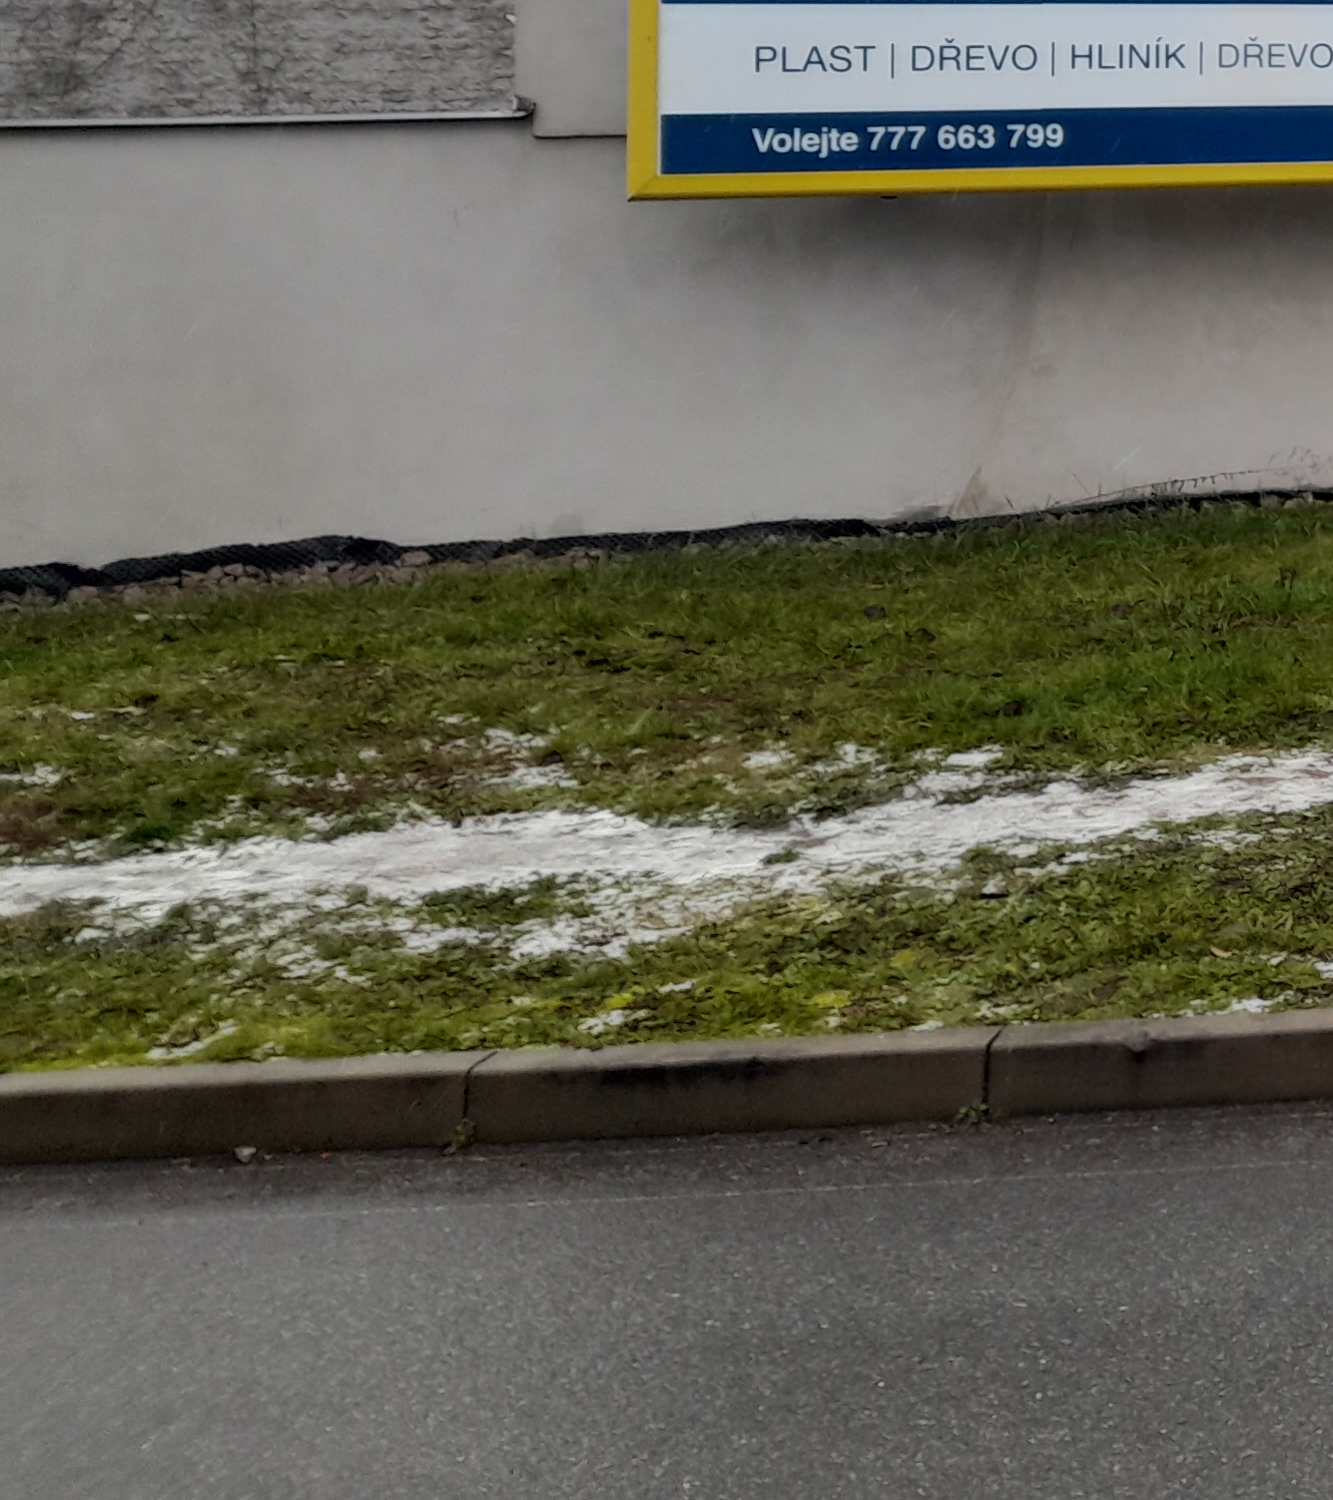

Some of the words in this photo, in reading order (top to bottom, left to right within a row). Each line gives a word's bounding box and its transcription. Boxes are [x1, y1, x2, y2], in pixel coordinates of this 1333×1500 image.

[755, 45, 876, 73] PLAST
[911, 37, 1038, 72] DŘEVO
[1071, 36, 1186, 70] HLINÍK
[751, 126, 859, 155] Volejte
[866, 125, 927, 151] 777
[937, 124, 996, 150] 663
[1006, 123, 1064, 148] 799
